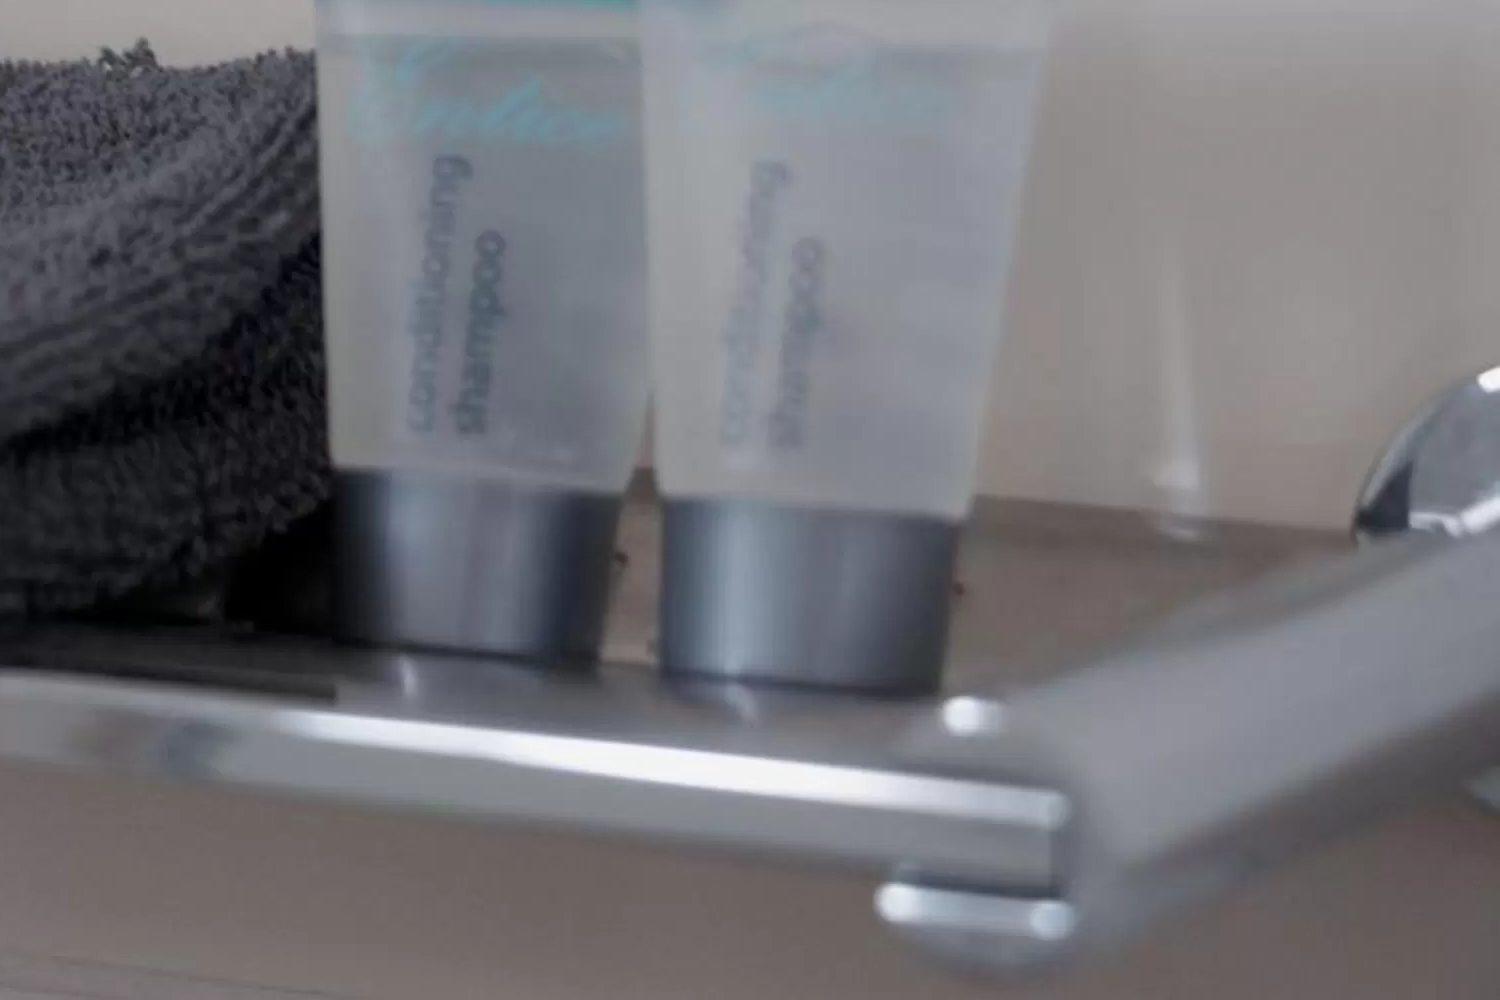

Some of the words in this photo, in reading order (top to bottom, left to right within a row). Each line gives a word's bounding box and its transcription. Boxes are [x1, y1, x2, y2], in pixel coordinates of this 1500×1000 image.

[406, 153, 474, 434] conditioning
[453, 228, 507, 435] shampoo
[766, 235, 824, 449] shampoo
